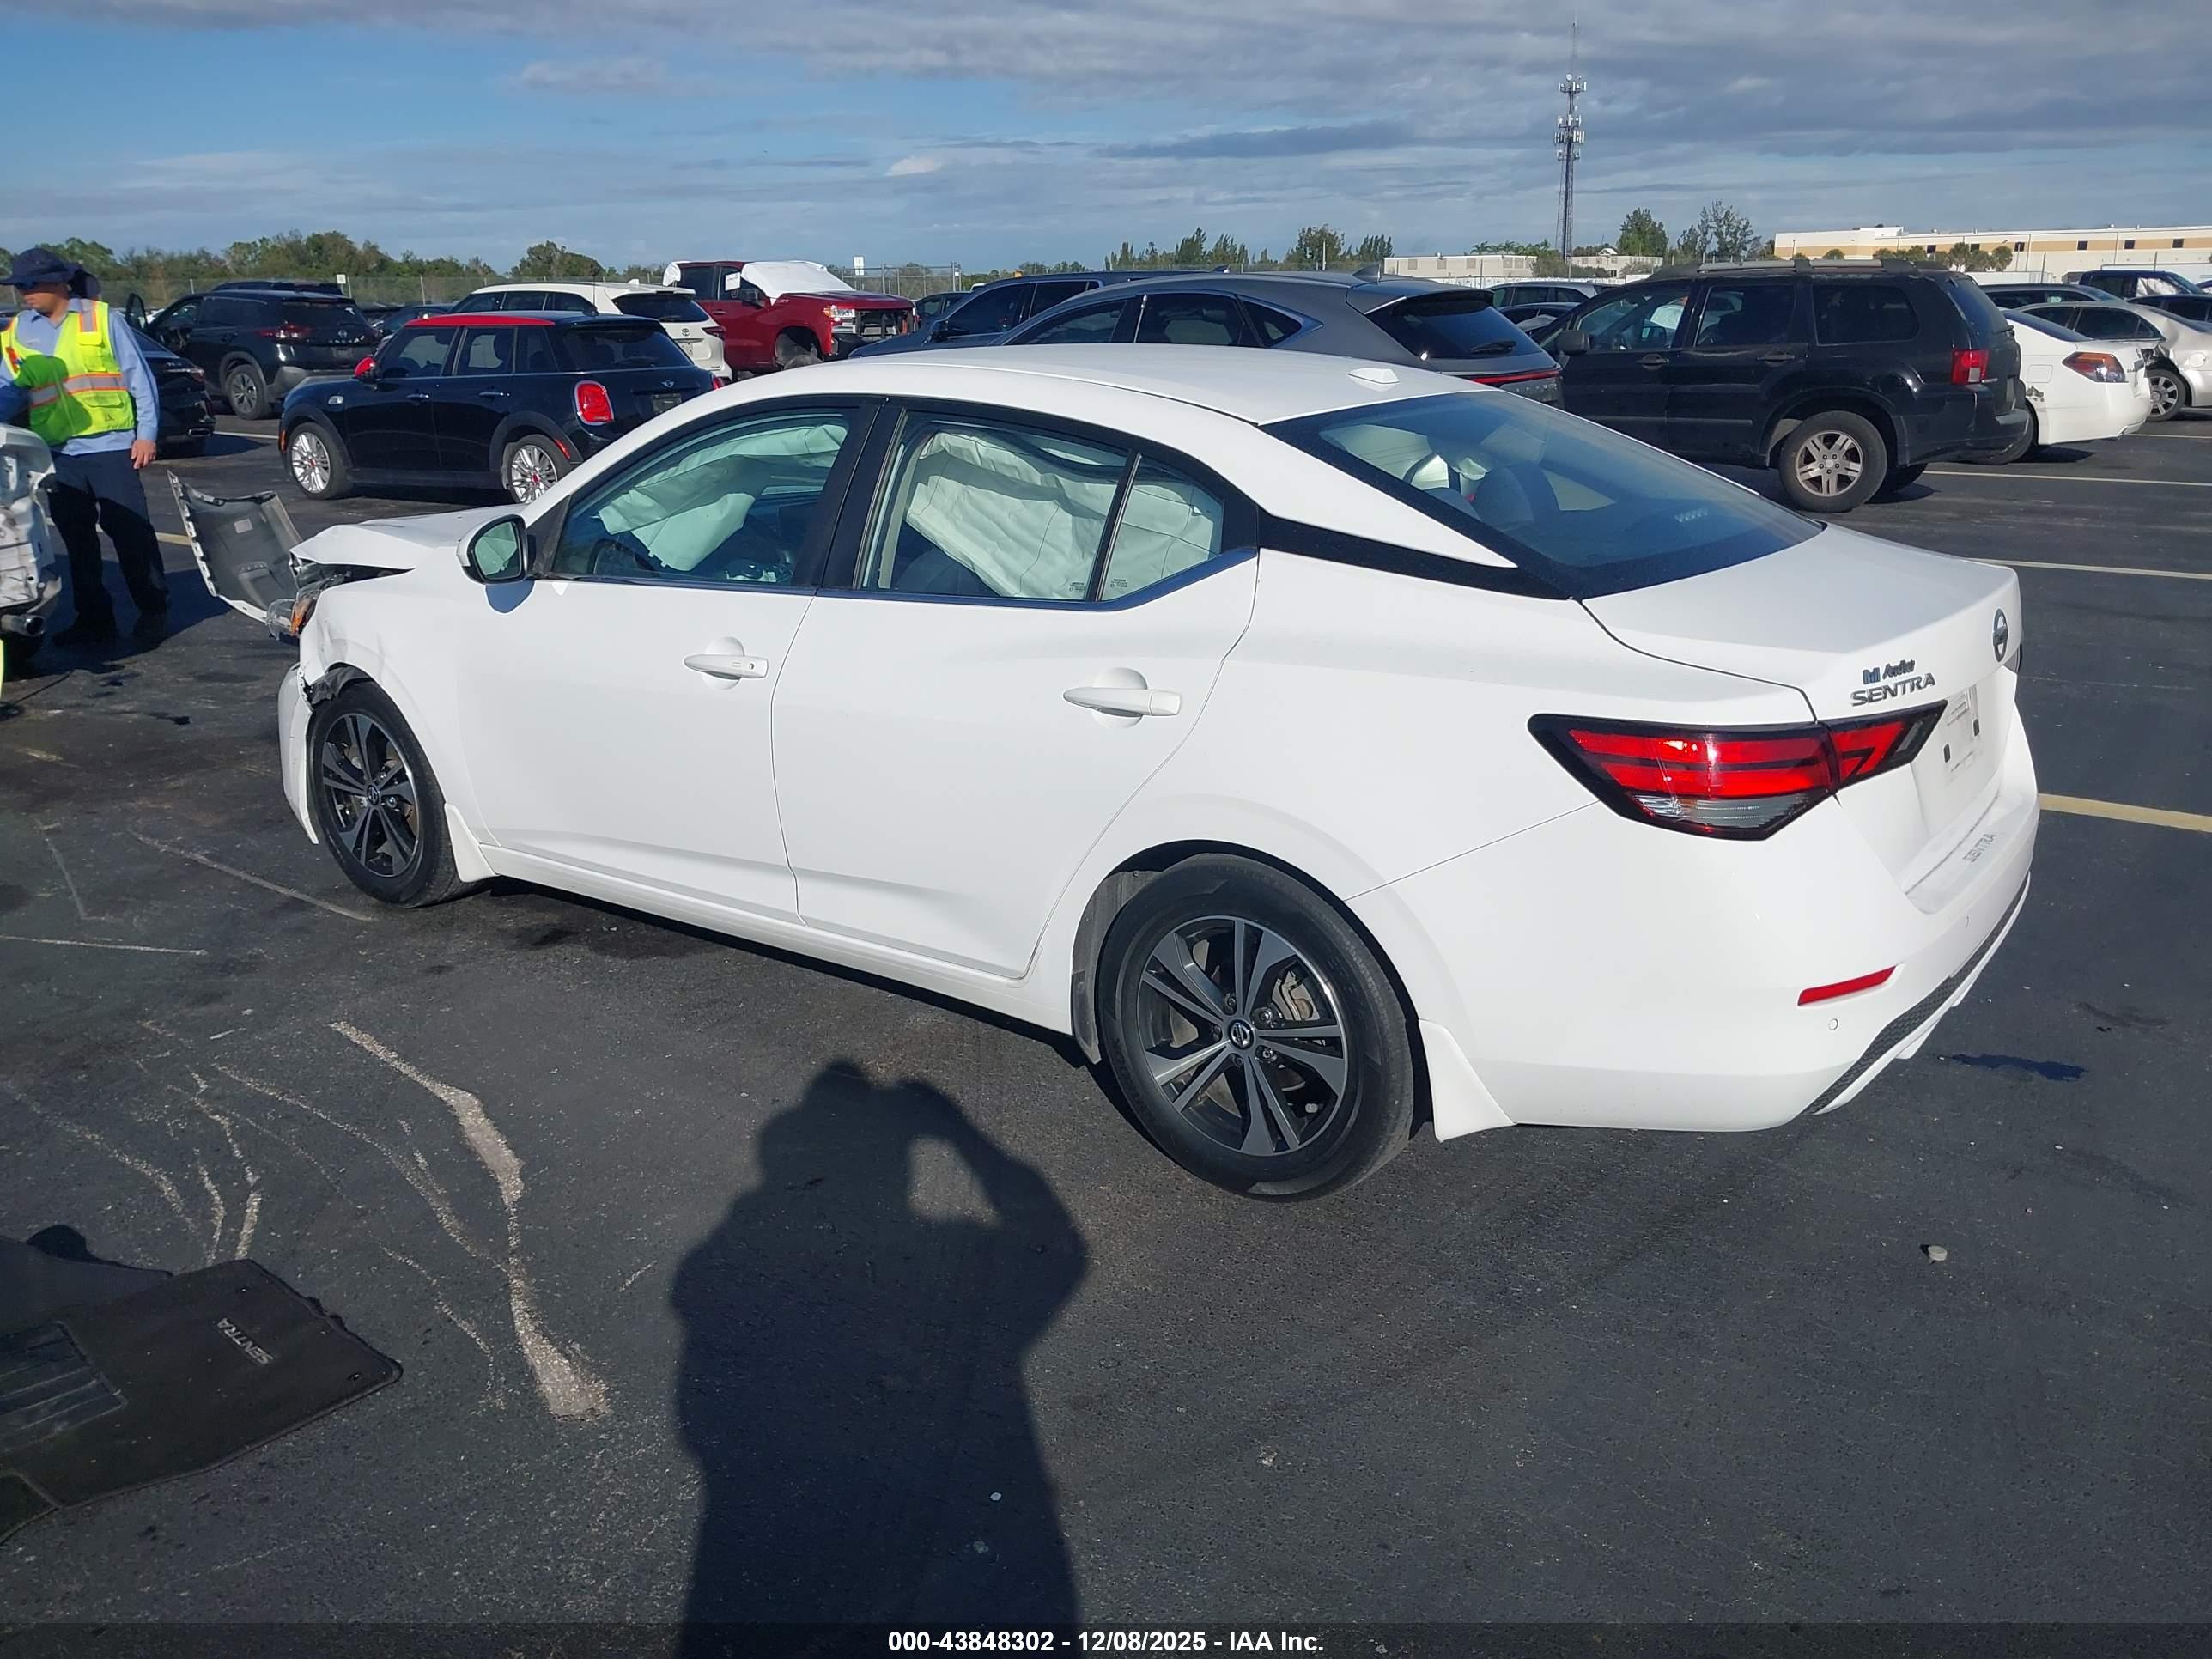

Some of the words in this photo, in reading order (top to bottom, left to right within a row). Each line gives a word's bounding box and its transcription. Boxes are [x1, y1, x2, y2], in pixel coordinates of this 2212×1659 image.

[1850, 672, 1936, 707] SENTRA
[1962, 833, 1996, 863] SENTRA
[217, 1317, 274, 1365] SENTRA
